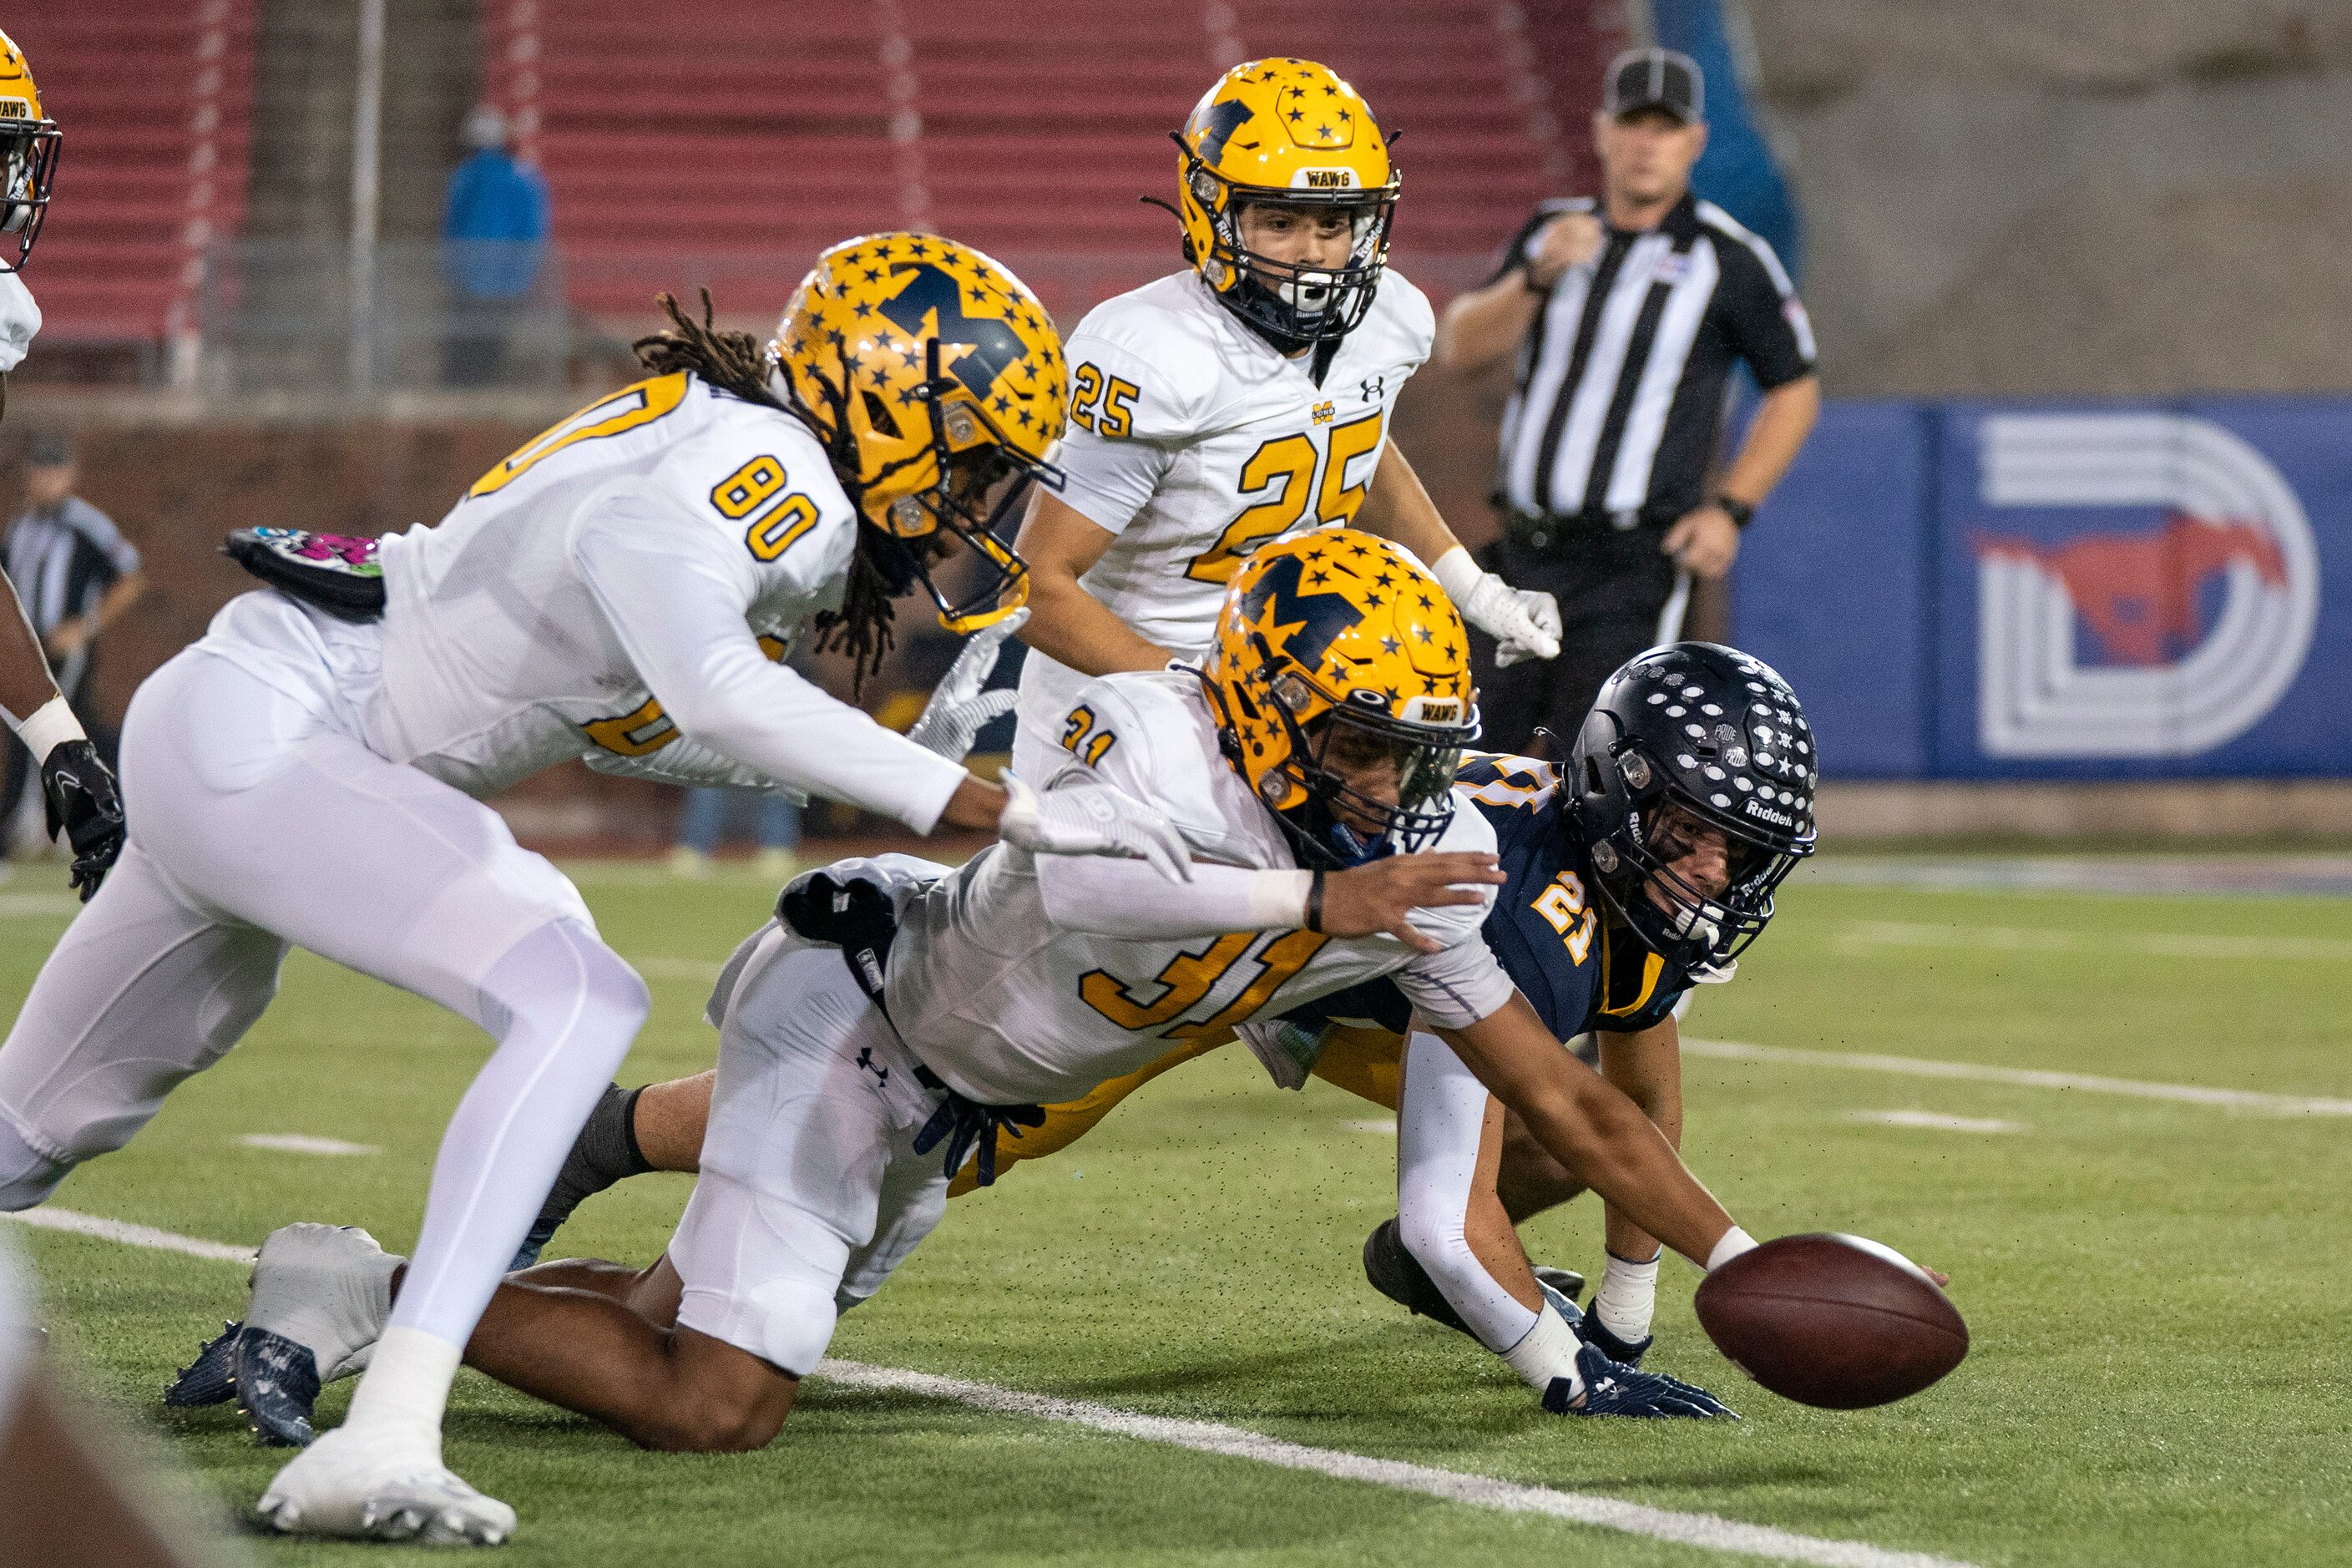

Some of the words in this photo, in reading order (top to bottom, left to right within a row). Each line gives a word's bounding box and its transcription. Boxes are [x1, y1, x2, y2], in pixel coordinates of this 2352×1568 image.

[1307, 171, 1350, 187] WAWG
[1070, 361, 1141, 437] 25
[709, 453, 822, 564] 80
[1182, 406, 1383, 585] 25
[1421, 702, 1459, 722] WAWG
[1714, 723, 1737, 743] PRIDE
[1745, 799, 1793, 827] Riddell
[1530, 869, 1598, 967] 21
